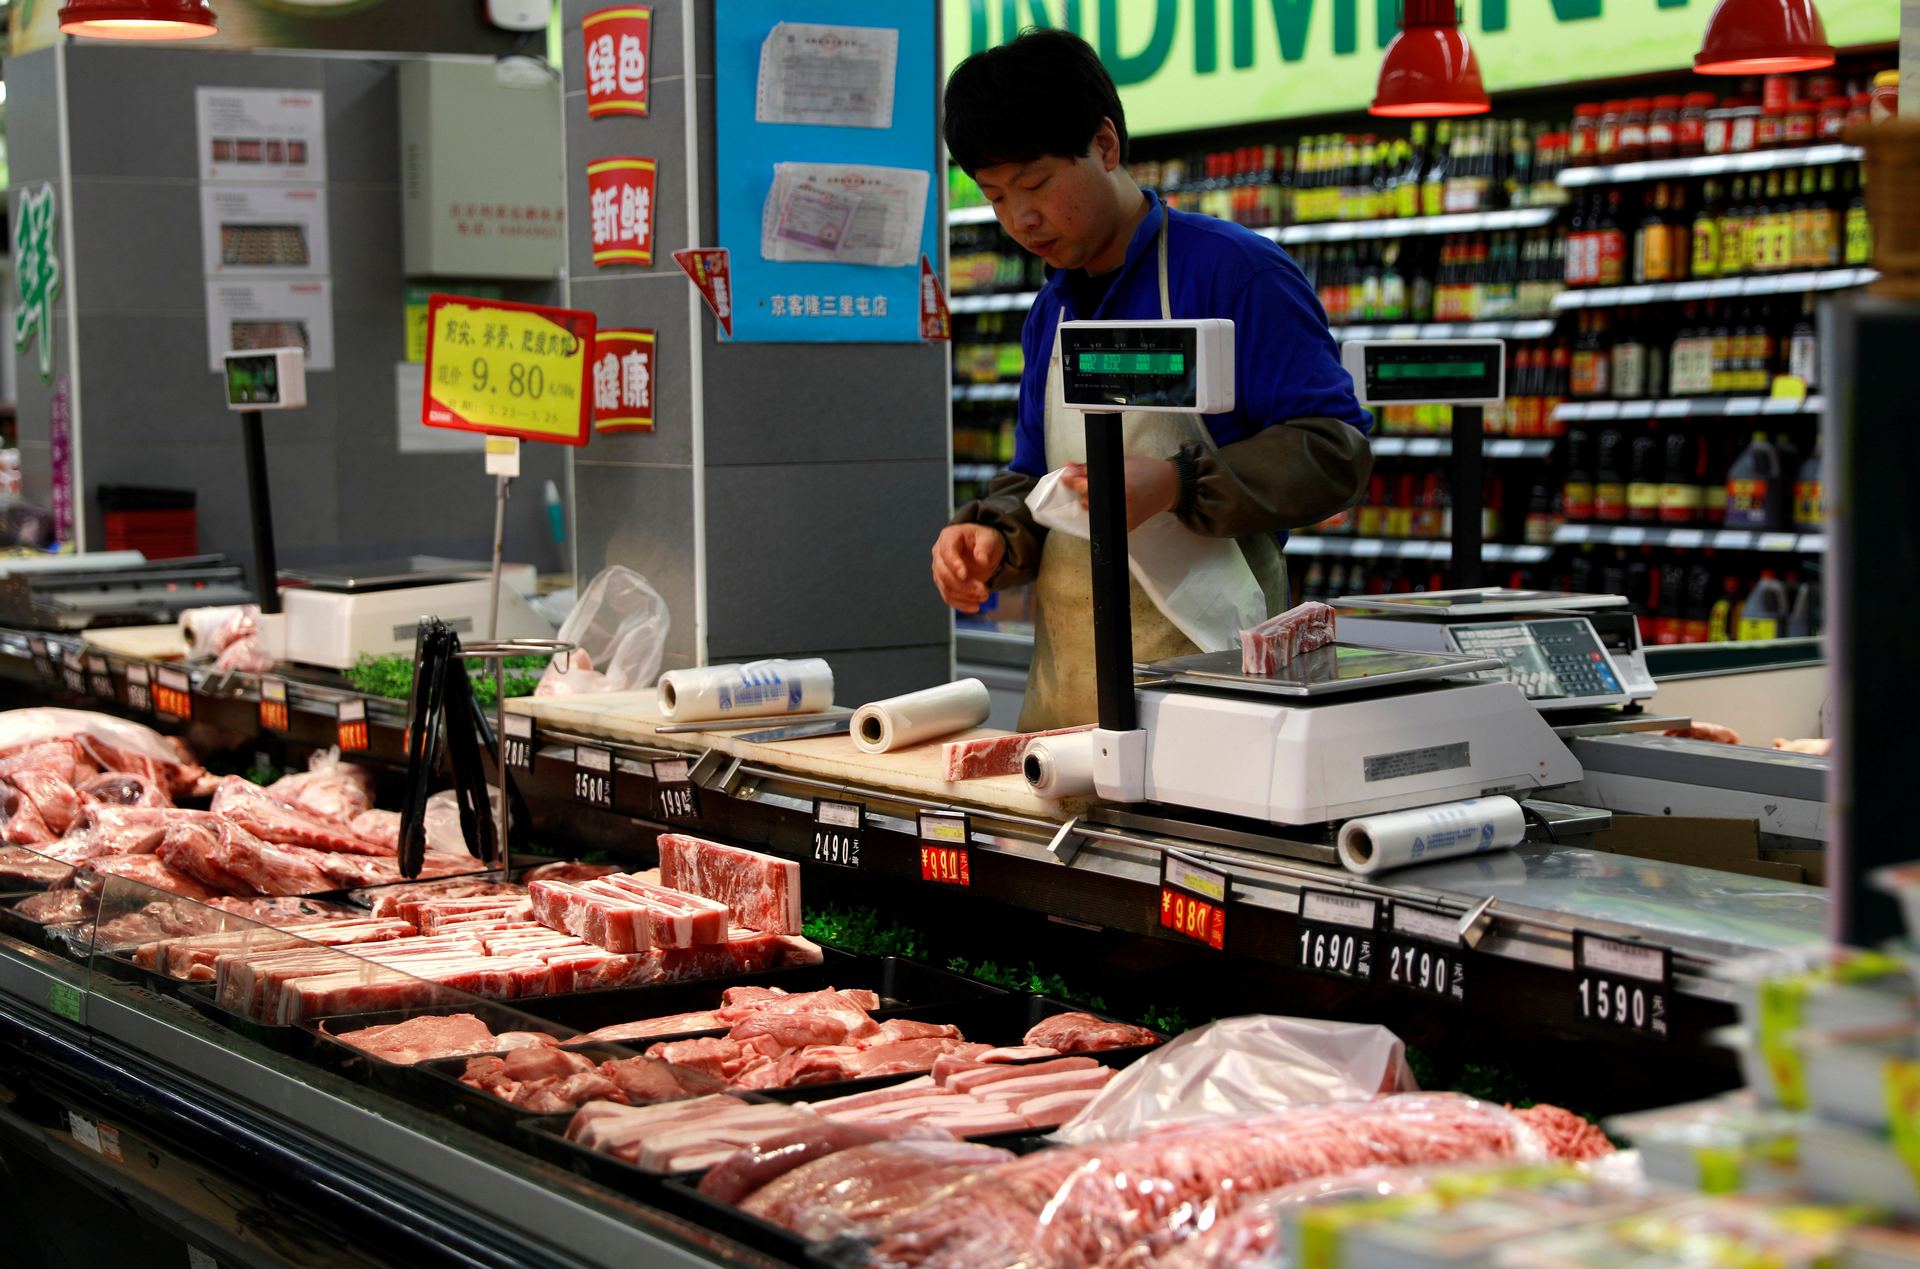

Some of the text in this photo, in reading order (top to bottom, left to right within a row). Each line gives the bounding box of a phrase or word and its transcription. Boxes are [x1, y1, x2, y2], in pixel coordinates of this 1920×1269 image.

[586, 33, 646, 96] 绿色
[592, 183, 650, 246] 新鲜
[771, 294, 888, 318] 京客隆三里屯店
[472, 356, 545, 401] 9.80
[593, 349, 650, 410] 健康
